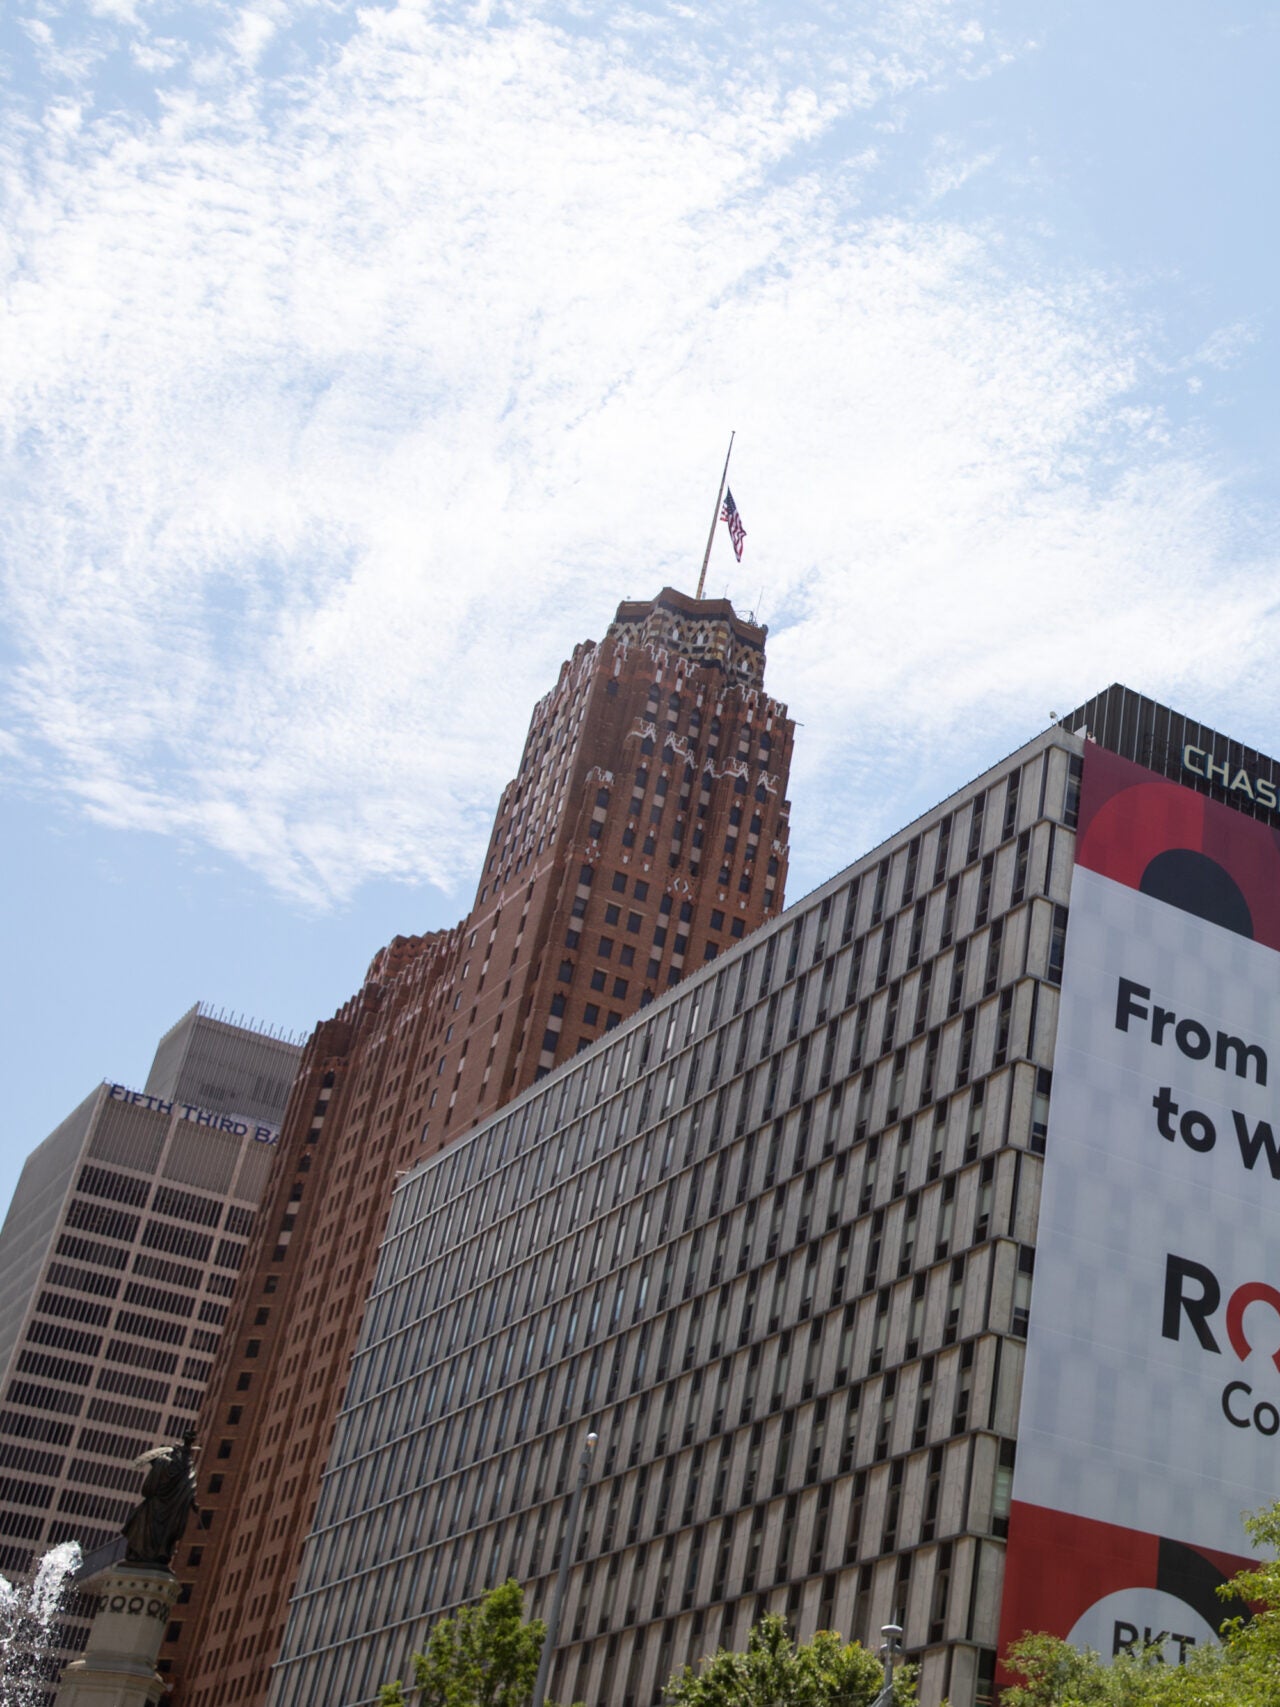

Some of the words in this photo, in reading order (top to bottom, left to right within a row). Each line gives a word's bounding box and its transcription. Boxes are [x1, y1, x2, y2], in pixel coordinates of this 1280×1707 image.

[1115, 976, 1268, 1087] From
[109, 1084, 174, 1116] FIFTH
[181, 1104, 248, 1137] THIRD
[1152, 1086, 1217, 1153] to
[1112, 1619, 1195, 1665] RKT
